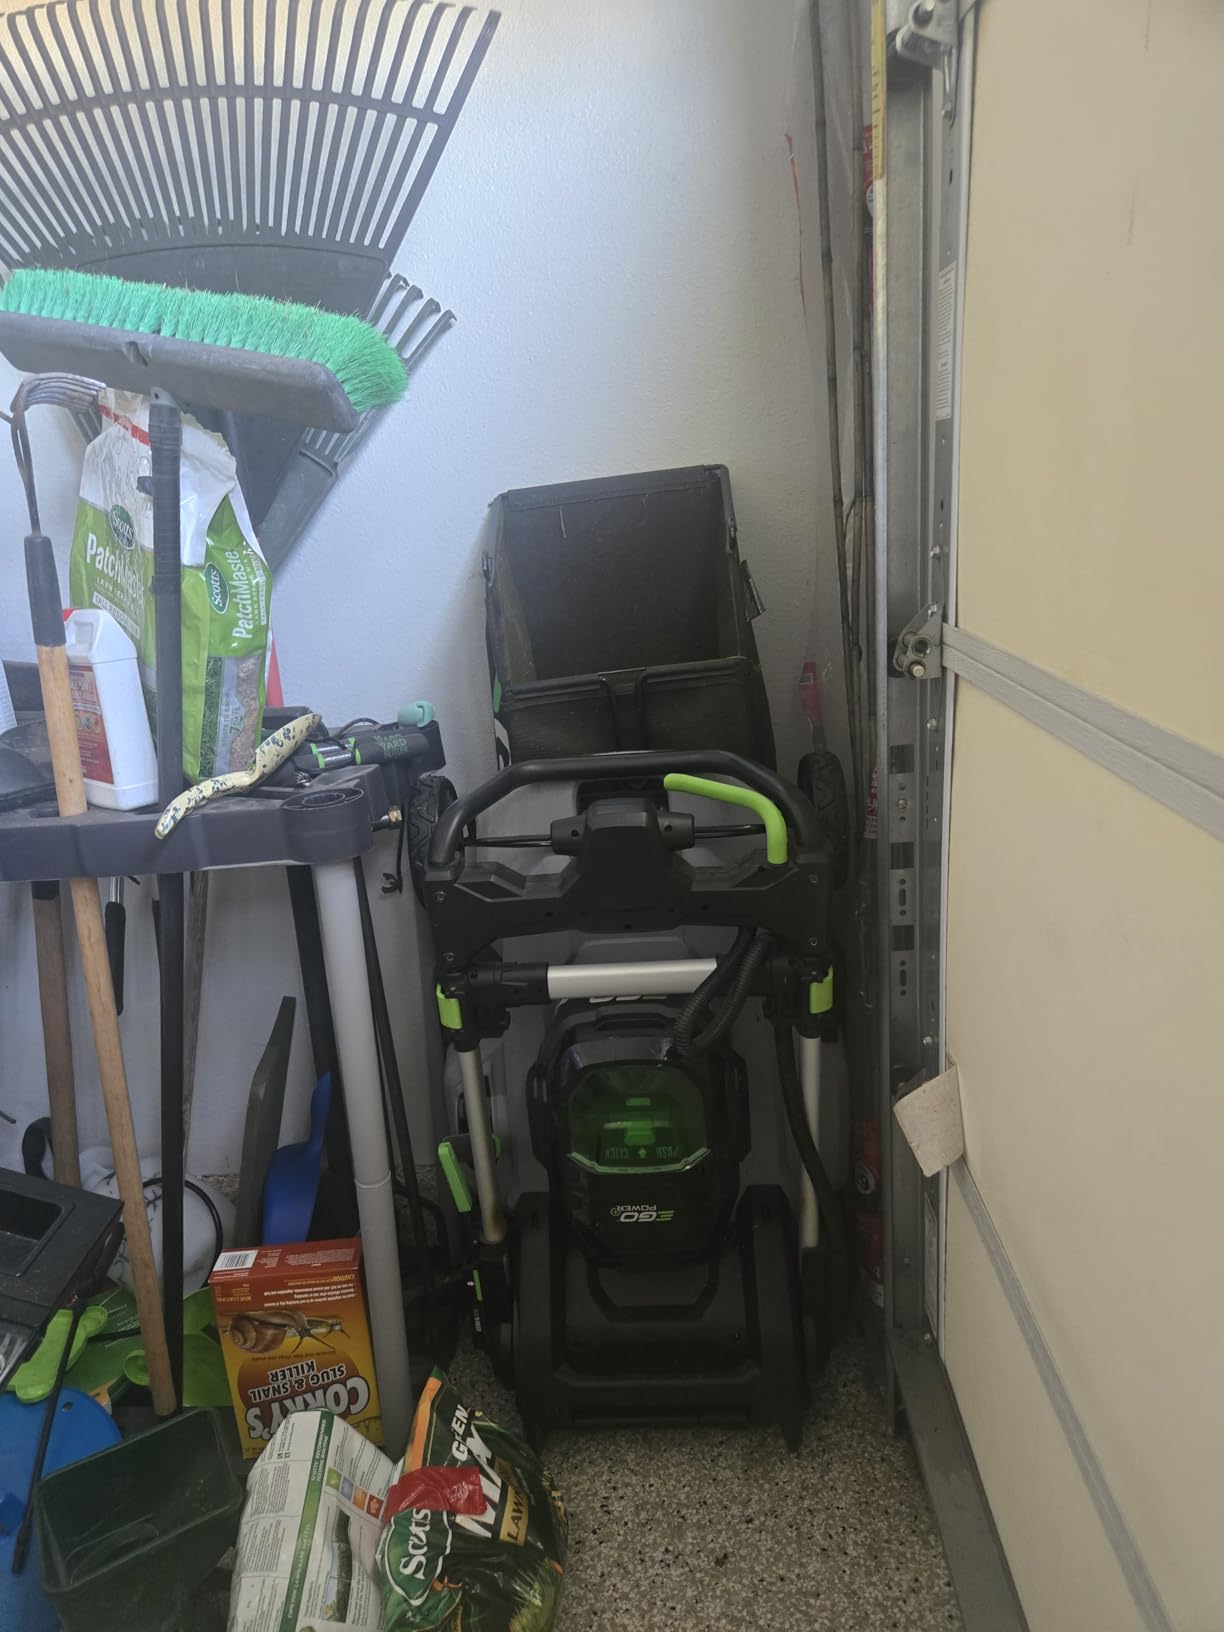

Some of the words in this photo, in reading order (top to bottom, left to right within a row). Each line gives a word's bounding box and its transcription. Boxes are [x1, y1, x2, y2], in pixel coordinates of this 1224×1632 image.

[112, 510, 134, 540] Scotts
[211, 568, 223, 607] Scotts
[225, 550, 253, 638] PatchMaste
[620, 1210, 675, 1222] EGO
[269, 1360, 316, 1383] KILLER
[310, 1364, 346, 1385] SLUG
[249, 1381, 290, 1402] SNAIL
[293, 1377, 306, 1389] &
